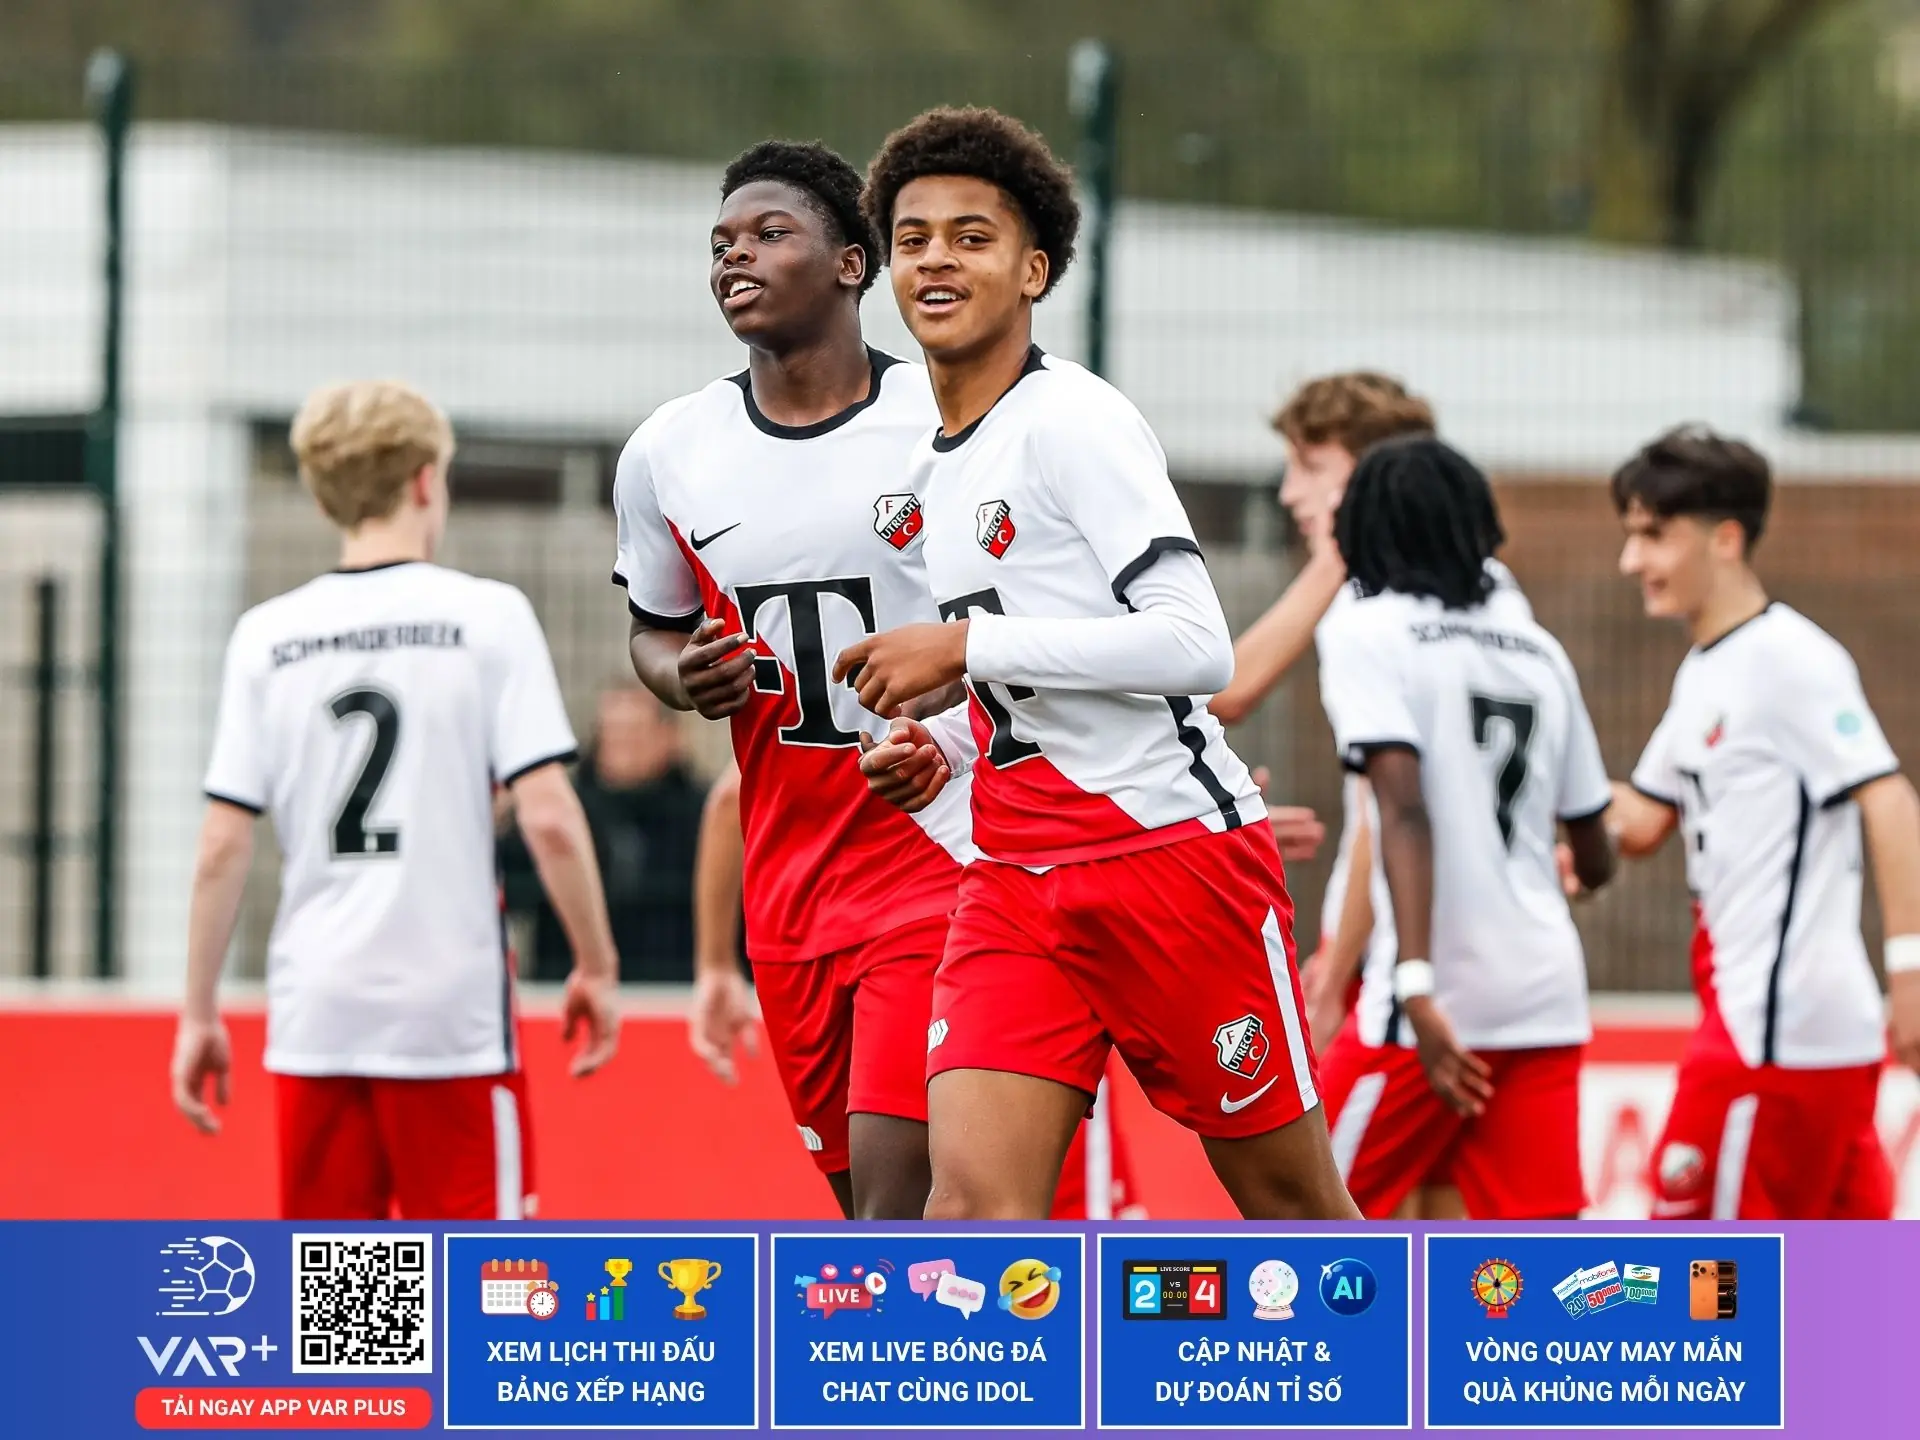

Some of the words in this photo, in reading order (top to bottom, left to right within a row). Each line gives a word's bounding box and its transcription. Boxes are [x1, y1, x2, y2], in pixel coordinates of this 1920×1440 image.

[885, 500, 894, 514] F
[881, 498, 919, 540] UTRECHT
[982, 508, 988, 523] F
[902, 522, 914, 536] C
[982, 503, 1008, 549] UTRECHT
[997, 529, 1009, 545] C
[330, 688, 401, 860] 2
[1470, 695, 1537, 850] 7
[1226, 1029, 1236, 1045] F
[1228, 1019, 1260, 1070] UTRECHT
[1248, 1045, 1261, 1060] C
